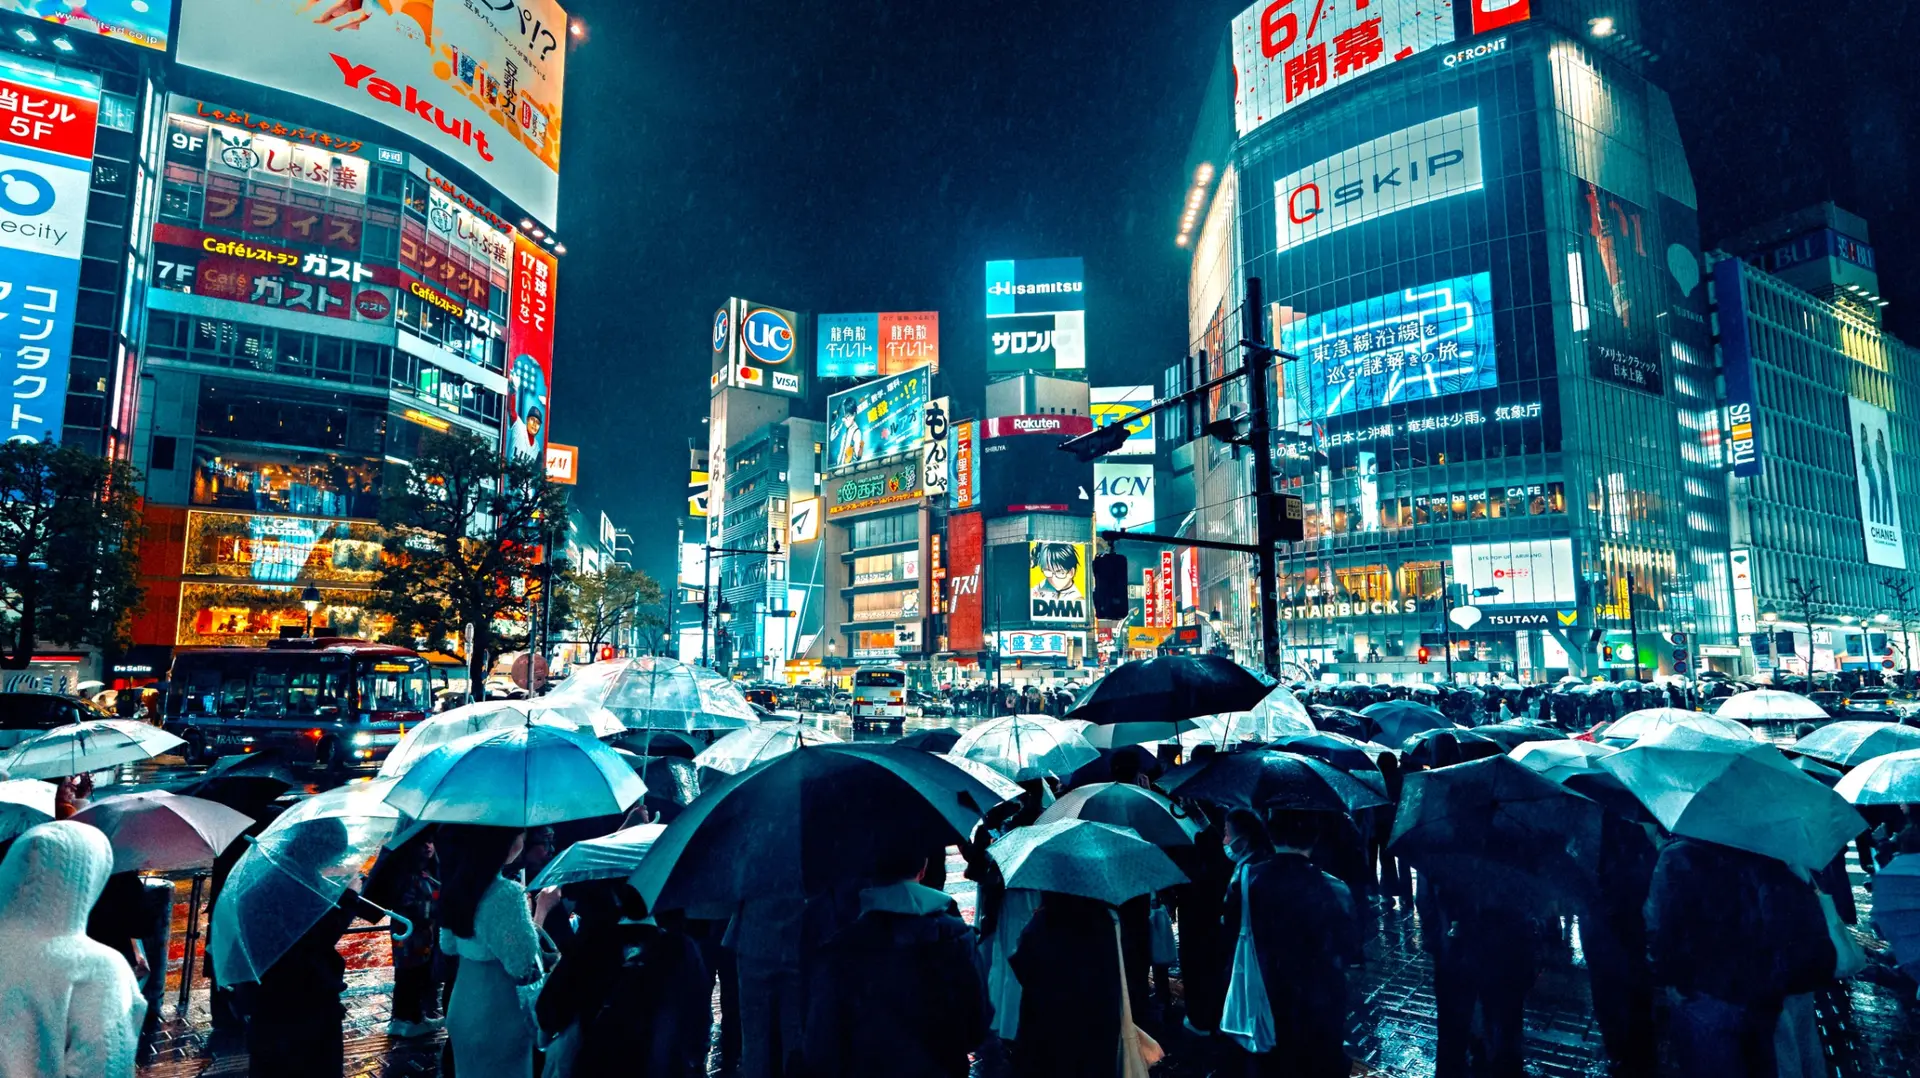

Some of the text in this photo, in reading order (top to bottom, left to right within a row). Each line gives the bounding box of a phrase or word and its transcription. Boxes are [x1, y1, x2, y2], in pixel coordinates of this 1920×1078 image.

[55, 11, 158, 44] www.it-ad.co.jp
[1261, 0, 1371, 59] 6/
[1284, 17, 1384, 104] 開幕
[1443, 37, 1507, 67] QFRONT
[328, 52, 494, 163] Yakult
[9, 116, 54, 140] 5F
[171, 132, 204, 153] 9F
[266, 148, 358, 190] しゃぶ葉
[206, 197, 357, 244] プライス
[157, 260, 196, 282] 7F
[302, 252, 374, 283] ガスト
[251, 274, 343, 314] ガスト
[533, 259, 549, 332] 野球って
[988, 281, 1083, 295] Hisamitsu
[358, 301, 388, 314] ガスト
[464, 307, 502, 339] ガスト
[748, 320, 791, 352] UC
[831, 326, 867, 342] 龍角散
[891, 324, 927, 341] 龍角散
[1311, 321, 1437, 365] 東急線沿線を
[1326, 340, 1459, 386] 巡る謎解きの旅
[775, 376, 798, 387] VISA
[1013, 417, 1060, 431] Rakuten
[1494, 402, 1541, 421] 気象庁
[925, 402, 948, 491] もんじゃ
[1729, 402, 1755, 465] SEIBU
[858, 480, 884, 499] 西村
[1094, 476, 1152, 496] ACN
[1416, 486, 1541, 506] Time based CAFE
[1870, 526, 1898, 542] CHANEL
[1163, 557, 1171, 594] カラオケ
[1032, 599, 1084, 618] DMM
[1283, 599, 1416, 620] STARBUCKS
[1489, 614, 1549, 625] TSUTAYA
